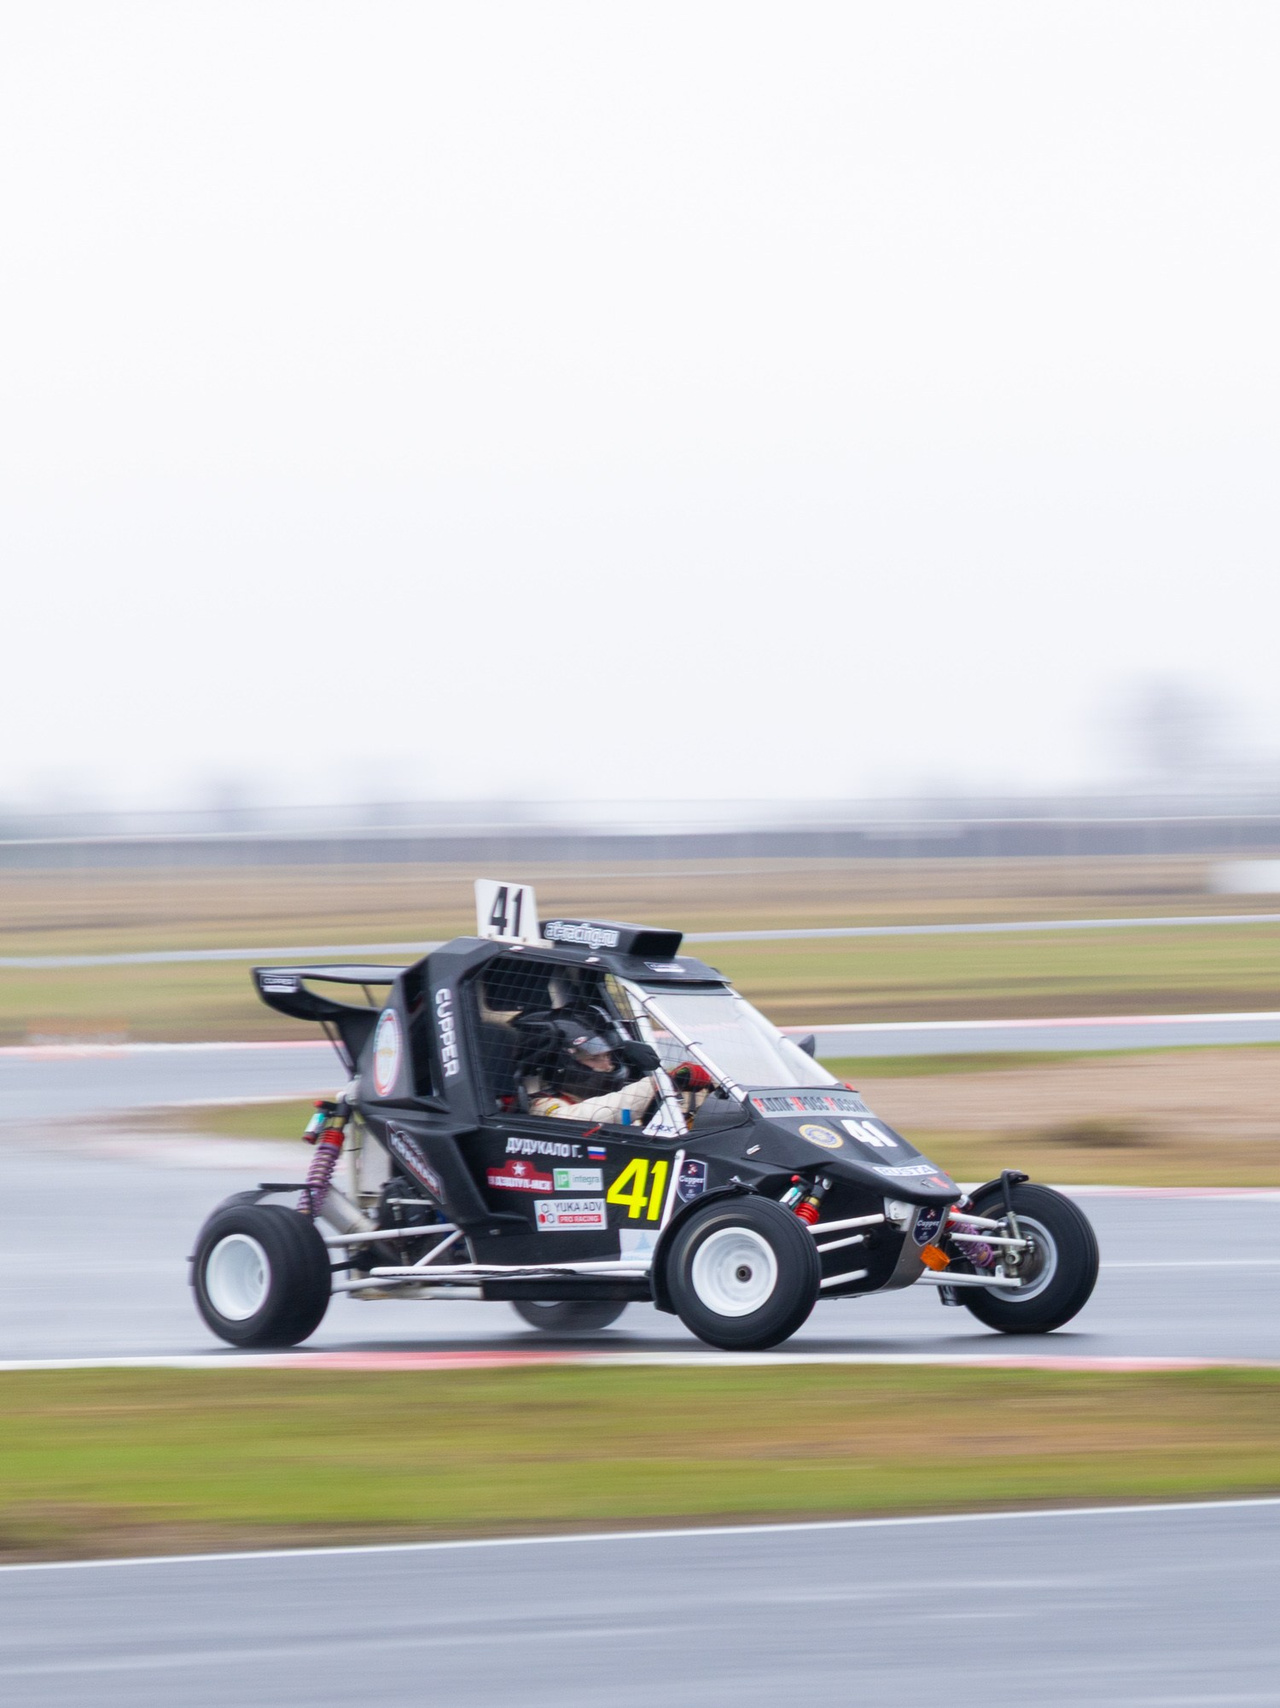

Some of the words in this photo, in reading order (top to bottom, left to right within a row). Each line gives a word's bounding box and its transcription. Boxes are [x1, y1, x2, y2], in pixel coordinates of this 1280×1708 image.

[489, 886, 523, 938] 41
[435, 988, 460, 1078] CUPPER
[840, 1119, 898, 1147] 41
[505, 1137, 571, 1158] ДУДУКАЛО
[572, 1144, 584, 1158] Г.
[573, 1174, 600, 1186] integra
[606, 1158, 668, 1221] 41
[554, 1202, 580, 1212] YUKA
